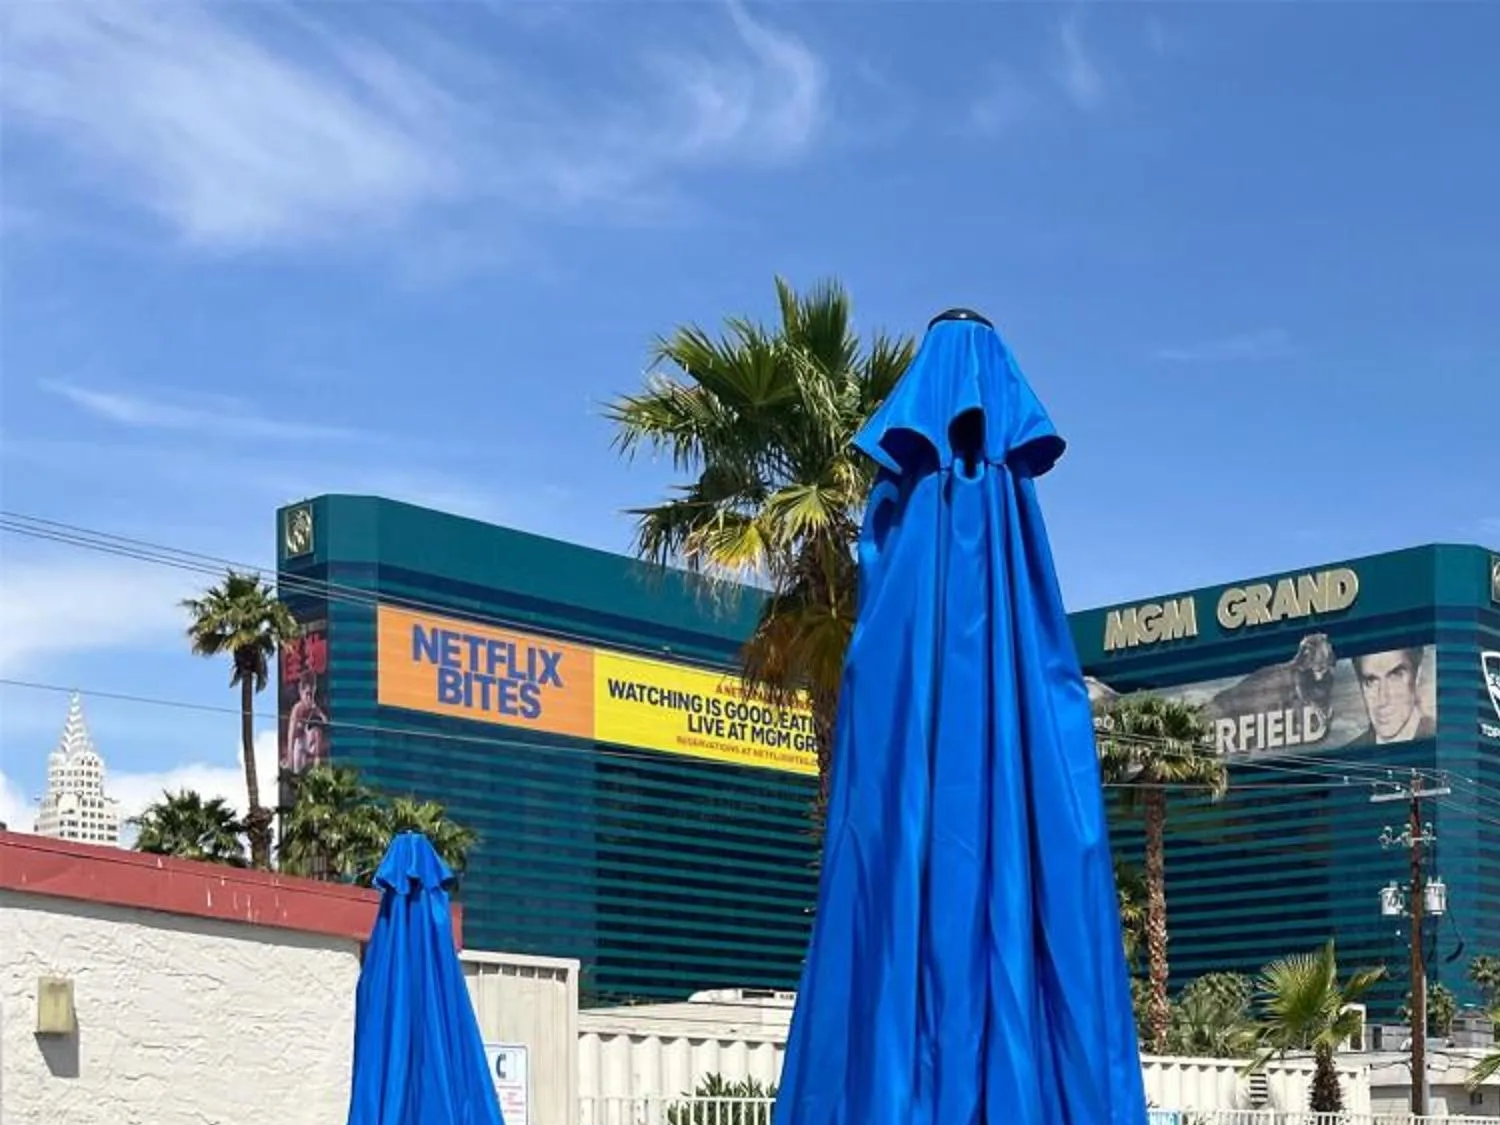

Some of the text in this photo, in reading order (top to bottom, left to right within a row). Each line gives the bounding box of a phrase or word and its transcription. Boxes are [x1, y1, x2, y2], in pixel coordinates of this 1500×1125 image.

[1104, 567, 1359, 651] MGM GRAND
[412, 623, 564, 688] NETFLIX
[437, 667, 542, 719] BITES
[608, 678, 703, 714] WATCHING
[705, 697, 721, 717] IS
[688, 713, 725, 738] LIVE
[727, 722, 748, 741] AT
[751, 725, 791, 750] MGM
